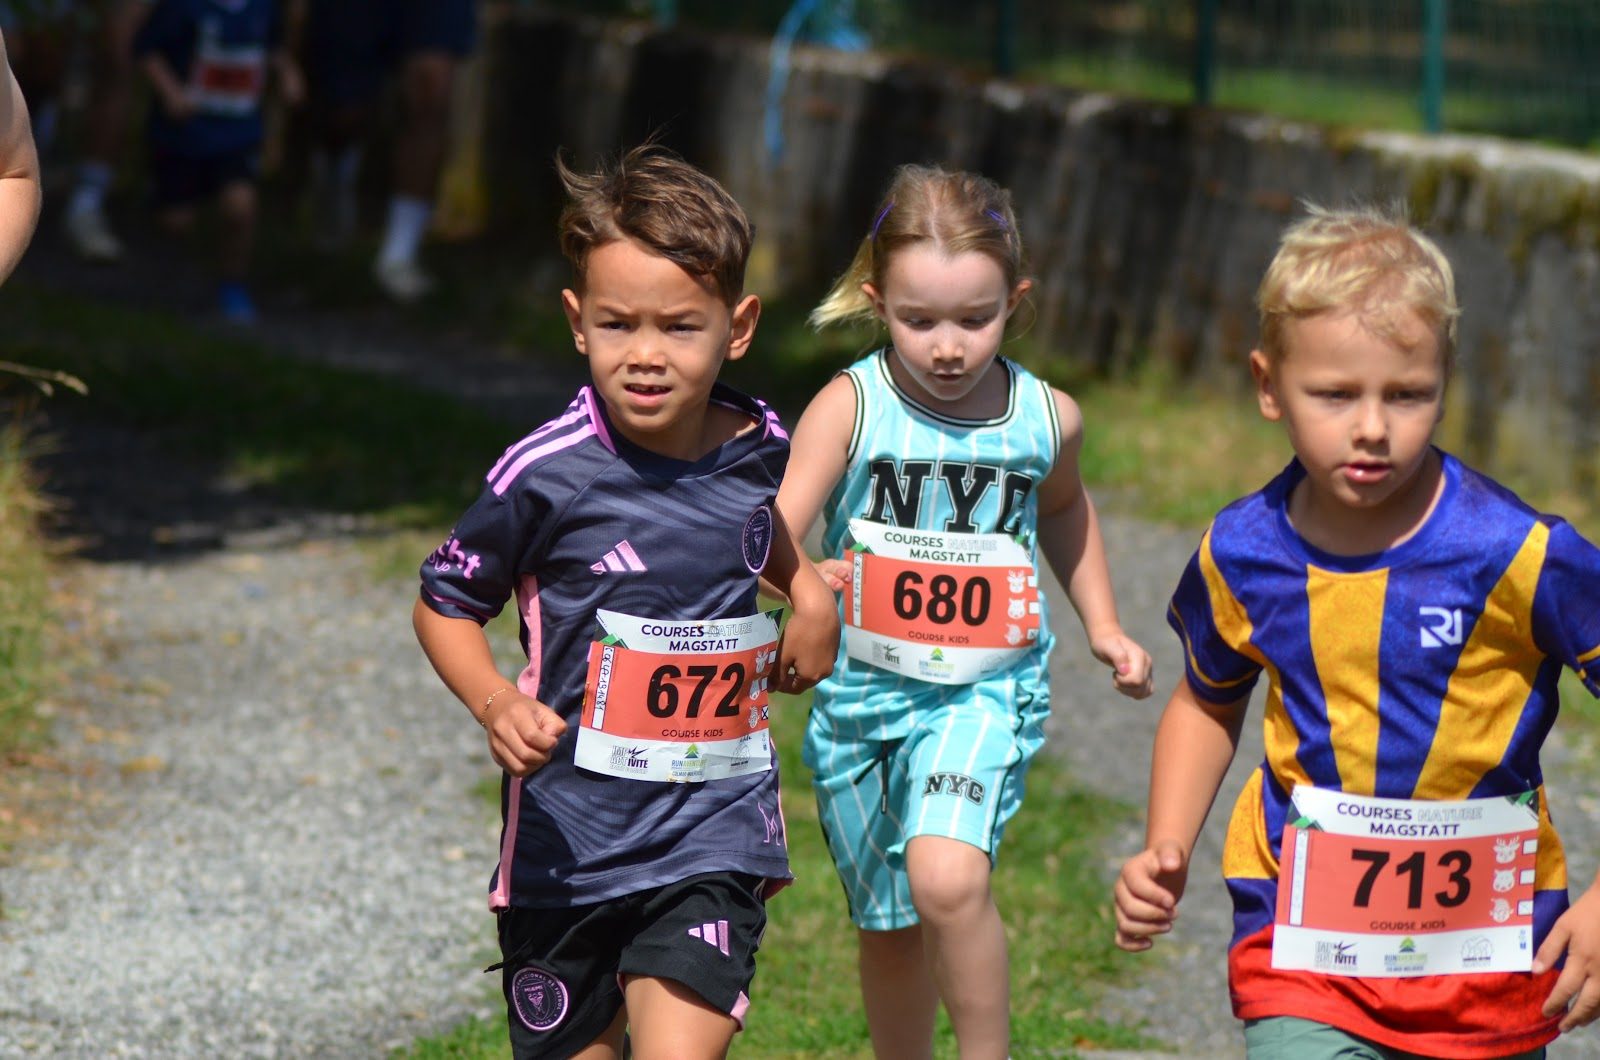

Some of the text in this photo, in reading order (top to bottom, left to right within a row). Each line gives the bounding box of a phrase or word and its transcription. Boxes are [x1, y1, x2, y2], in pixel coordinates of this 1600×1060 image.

[884, 532, 944, 548] COURSES
[909, 548, 982, 563] MAGSTATT
[893, 570, 991, 626] 680
[641, 624, 705, 638] COURSES
[908, 630, 970, 644] COURSE KIDS
[669, 638, 739, 652] MAGSTATT
[646, 662, 746, 719] 672
[661, 729, 724, 738] COURSE KIDS
[921, 772, 985, 806] NYC
[1337, 802, 1483, 822] COURSES NATURE
[1369, 823, 1460, 837] MAGSTATT
[1350, 848, 1473, 910] 713
[1369, 919, 1447, 931] COURSE KIDS
